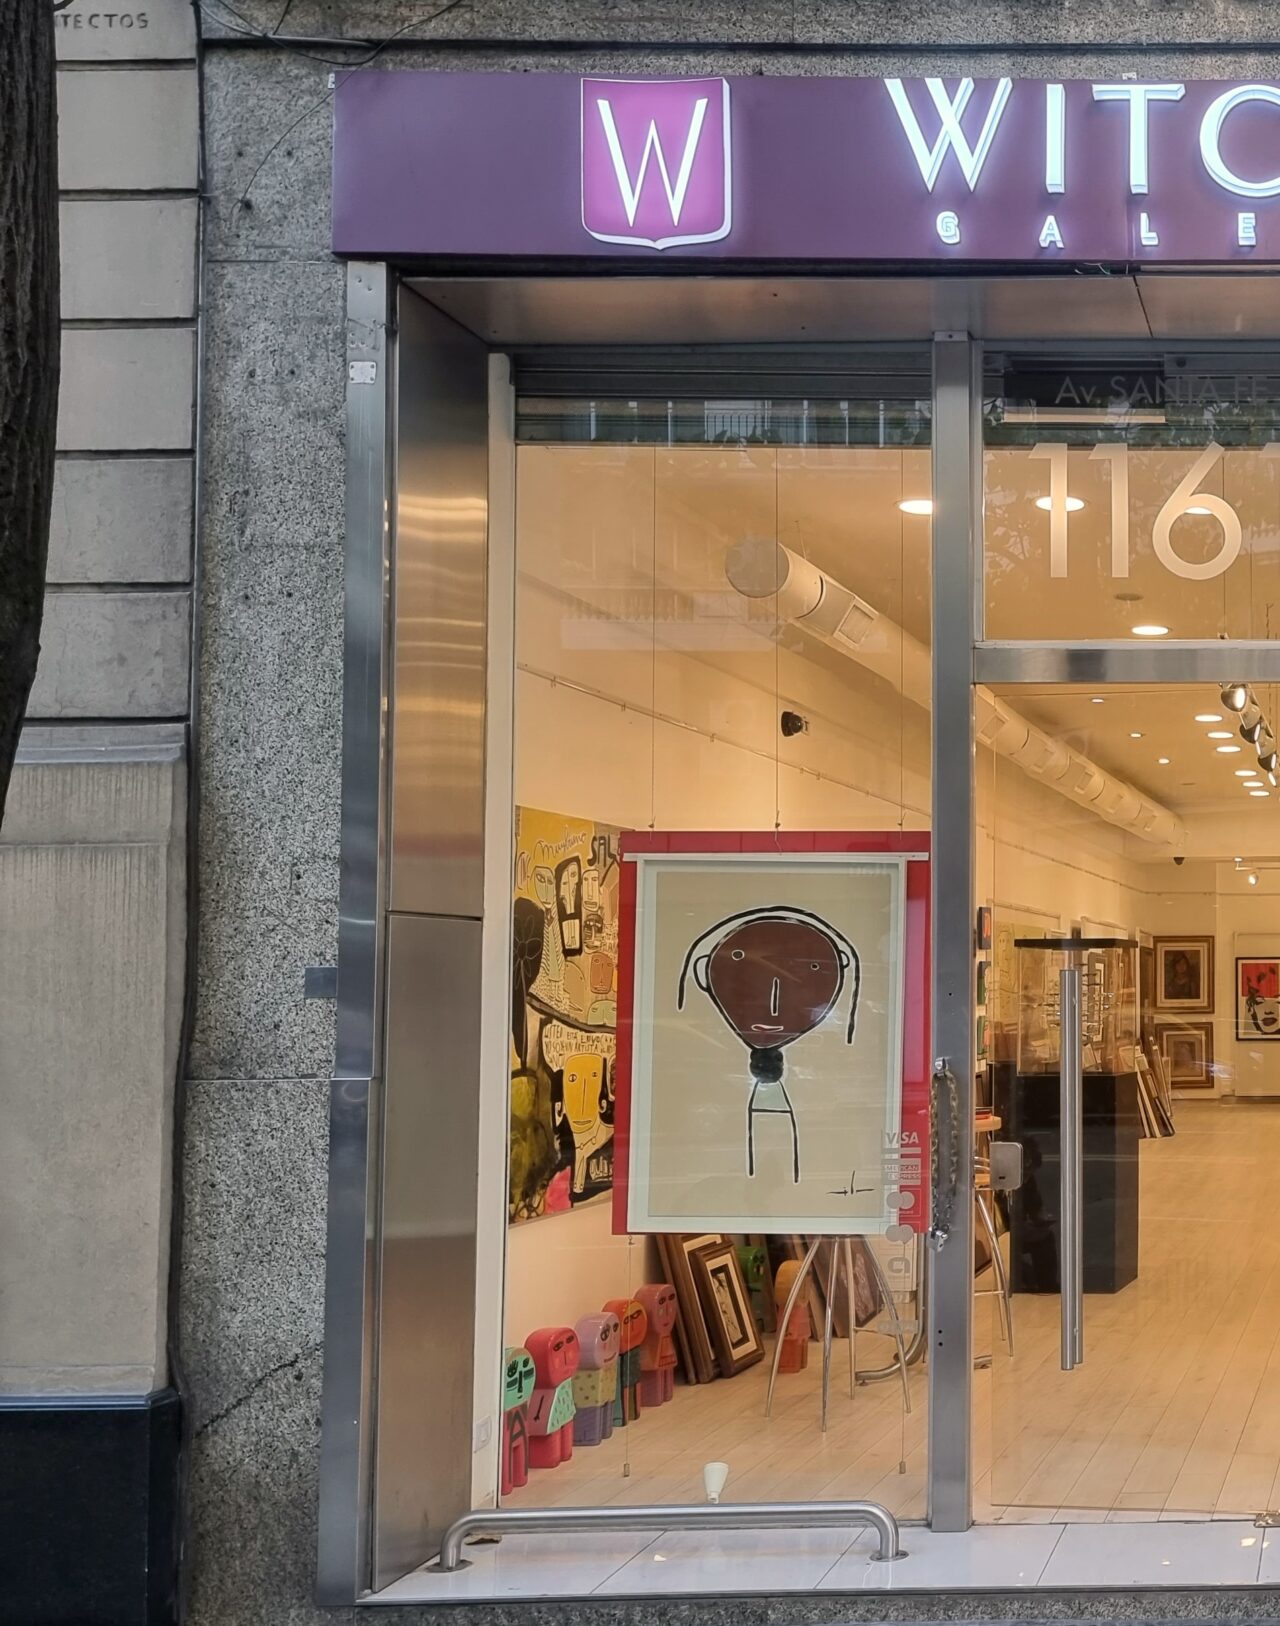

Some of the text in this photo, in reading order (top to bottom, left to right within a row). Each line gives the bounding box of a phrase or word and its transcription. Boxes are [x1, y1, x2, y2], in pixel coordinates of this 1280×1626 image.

[597, 98, 708, 227] W
[1110, 375, 1220, 404] SANTA
[1235, 376, 1269, 404] FE
[886, 1132, 919, 1144] VISA
